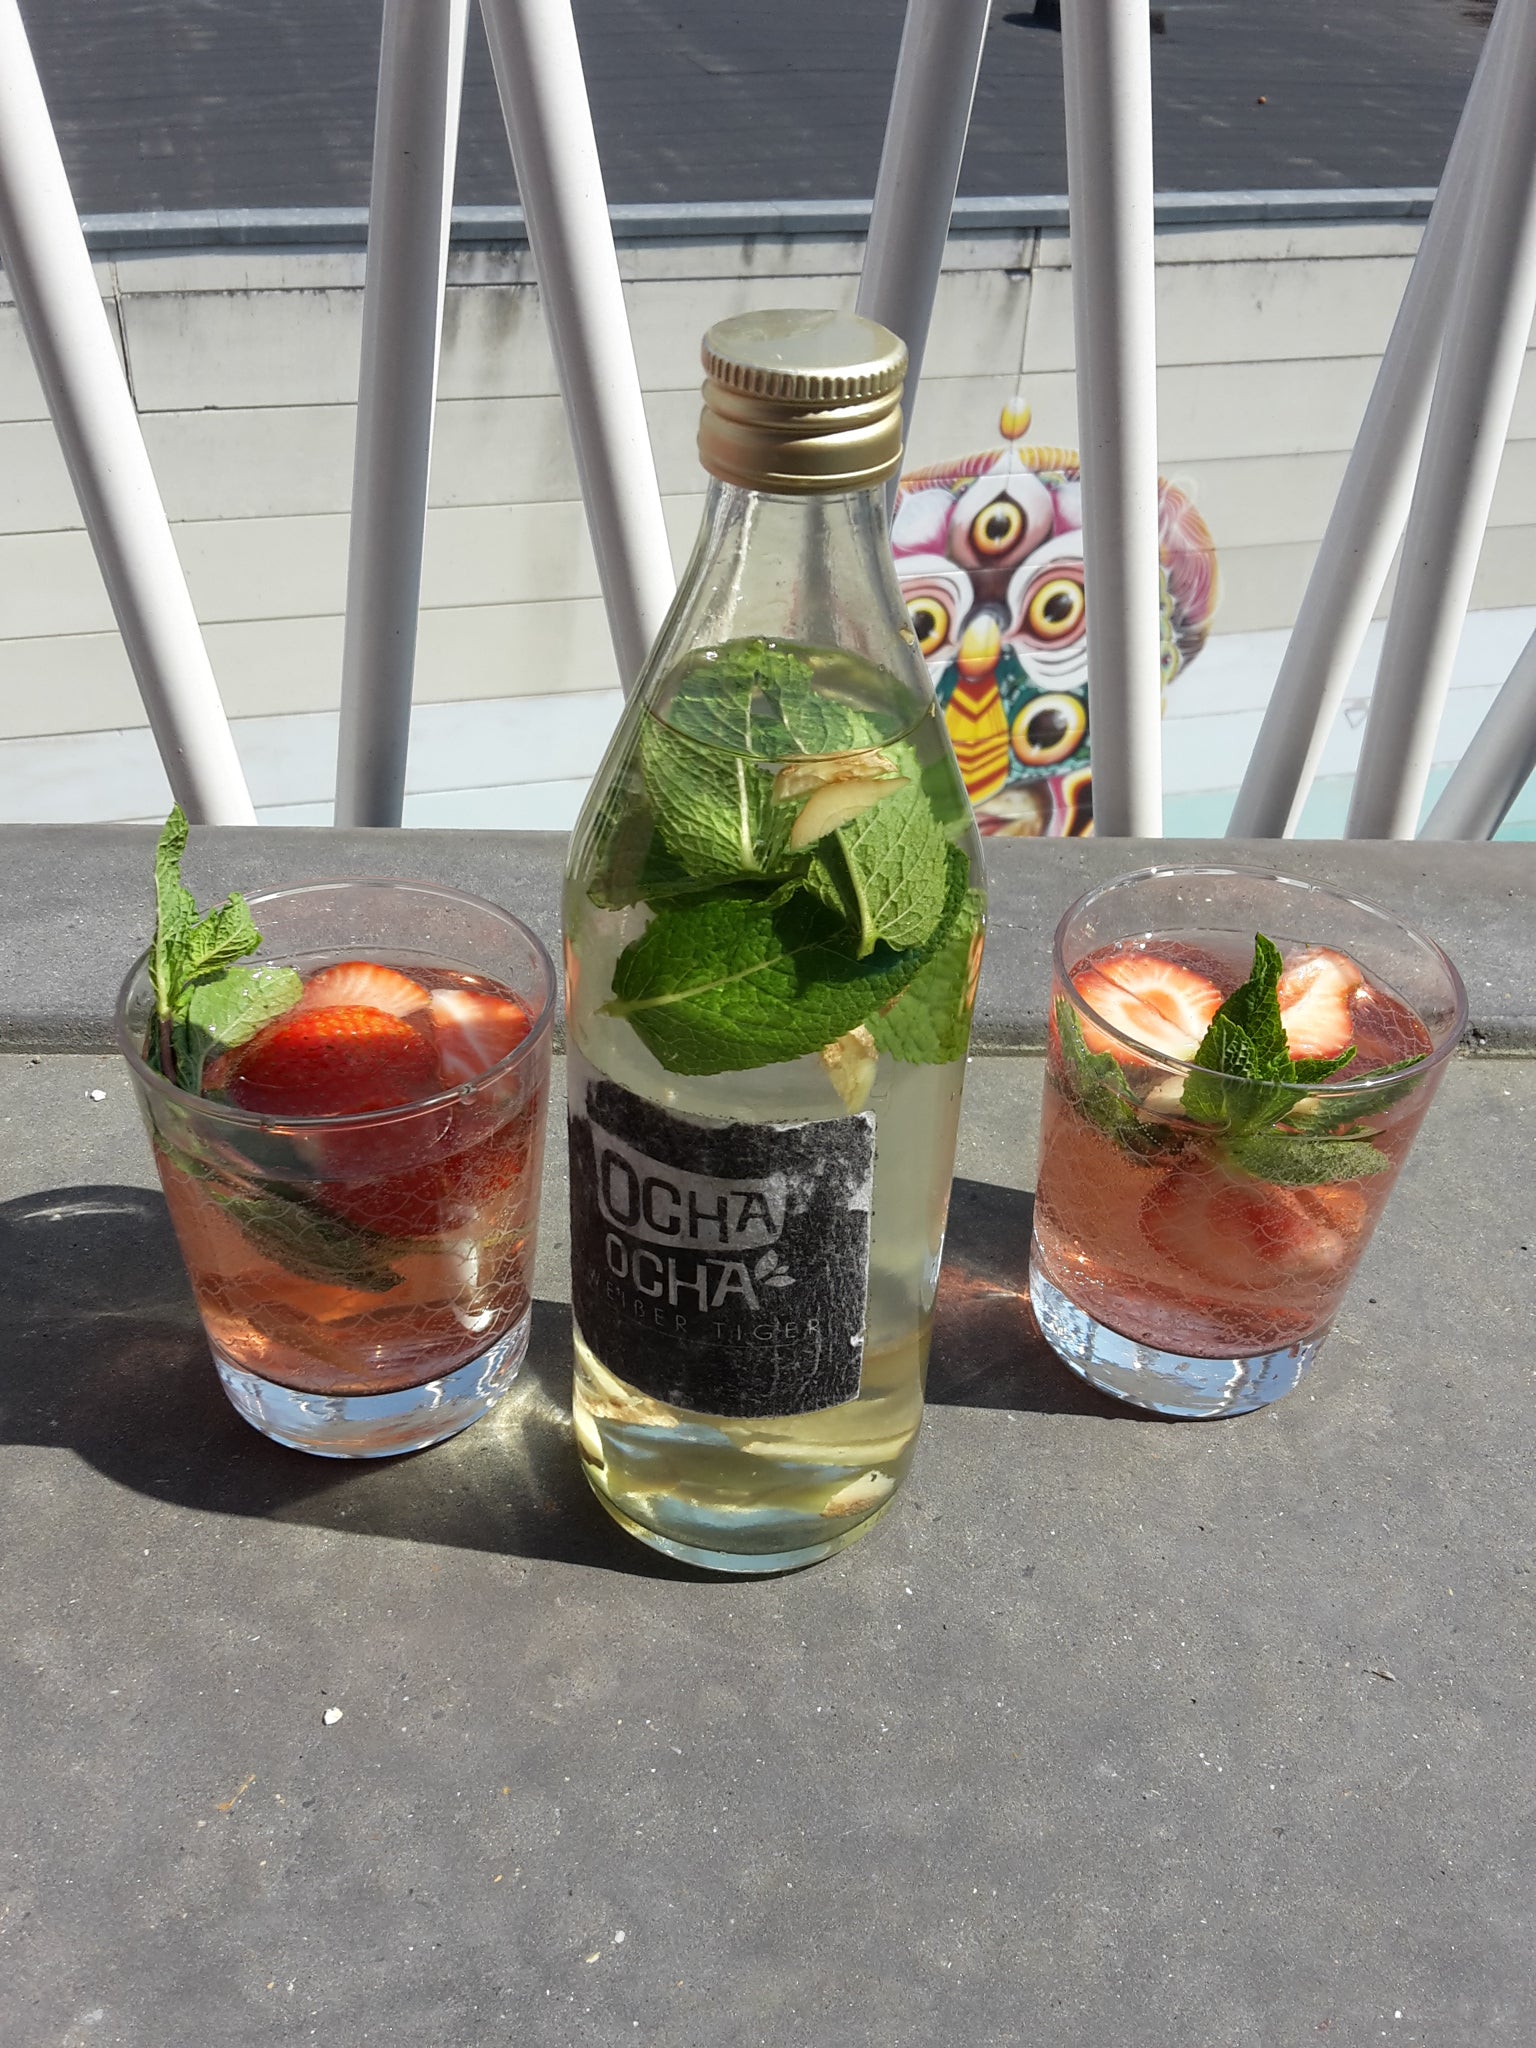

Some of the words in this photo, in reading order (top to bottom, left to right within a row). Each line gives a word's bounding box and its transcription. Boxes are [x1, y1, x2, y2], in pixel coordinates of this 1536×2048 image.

[600, 1148, 780, 1244] OCHA
[604, 1232, 760, 1312] OCHA
[713, 1318, 822, 1341] TIGER
